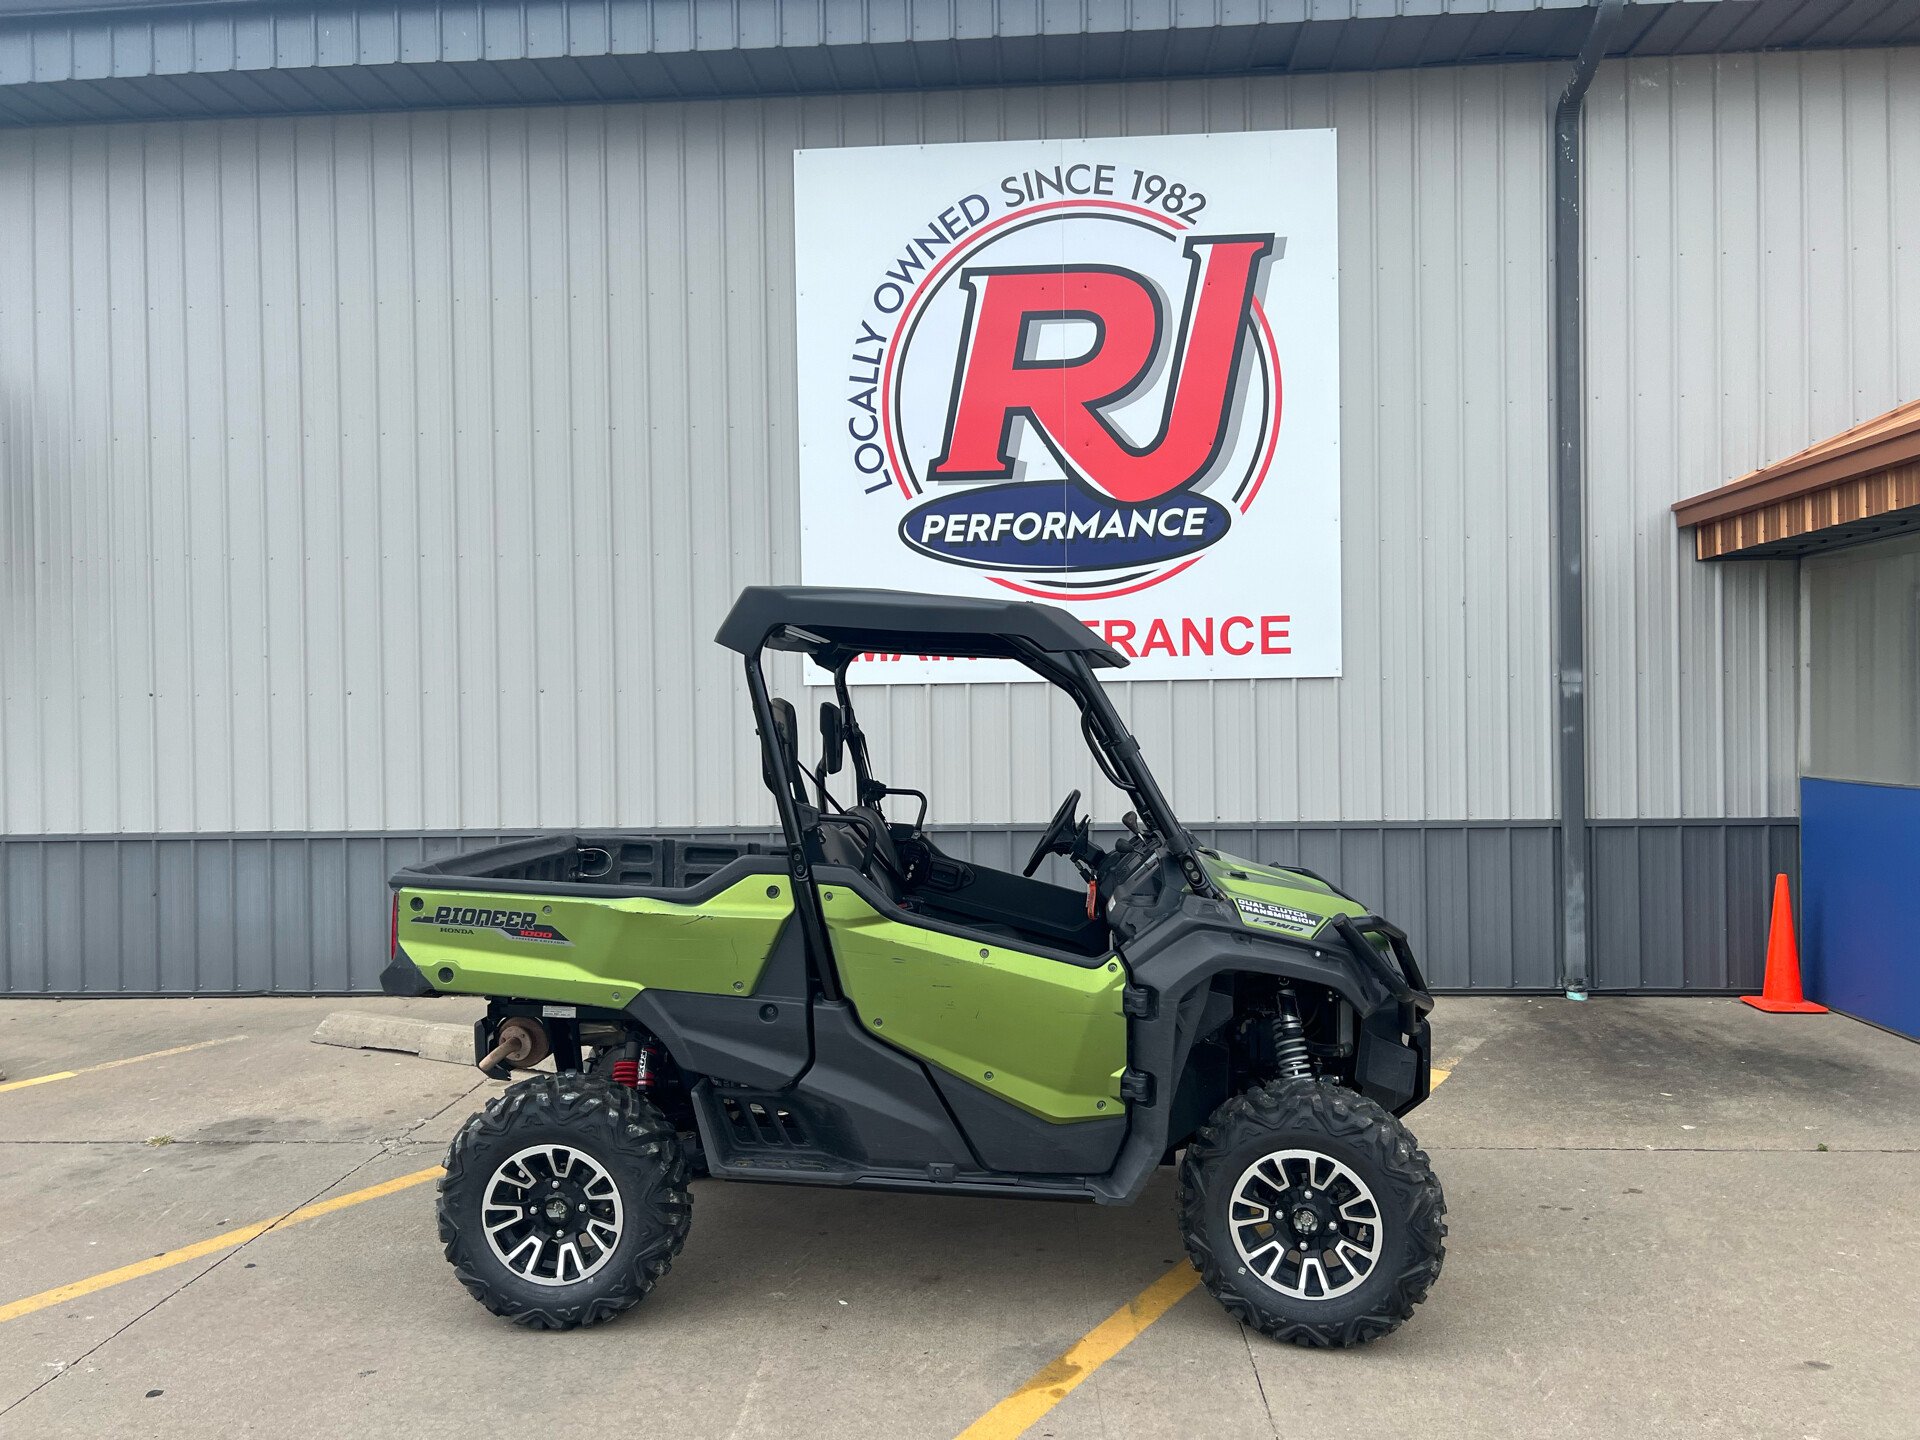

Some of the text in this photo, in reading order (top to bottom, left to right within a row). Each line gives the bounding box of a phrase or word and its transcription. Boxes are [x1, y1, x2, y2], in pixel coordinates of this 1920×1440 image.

[847, 163, 1207, 495] LOCALLY OWNED SINCE 1982
[926, 232, 1288, 505] RJ
[920, 507, 1208, 543] PERFORMANCE
[1080, 614, 1293, 658] RANCE
[434, 906, 537, 929] PIONEER
[1238, 898, 1308, 919] DUAL CLUTCH
[1240, 905, 1316, 925] TRANSMISSION
[440, 927, 475, 935] HONDA
[520, 930, 552, 938] 1000
